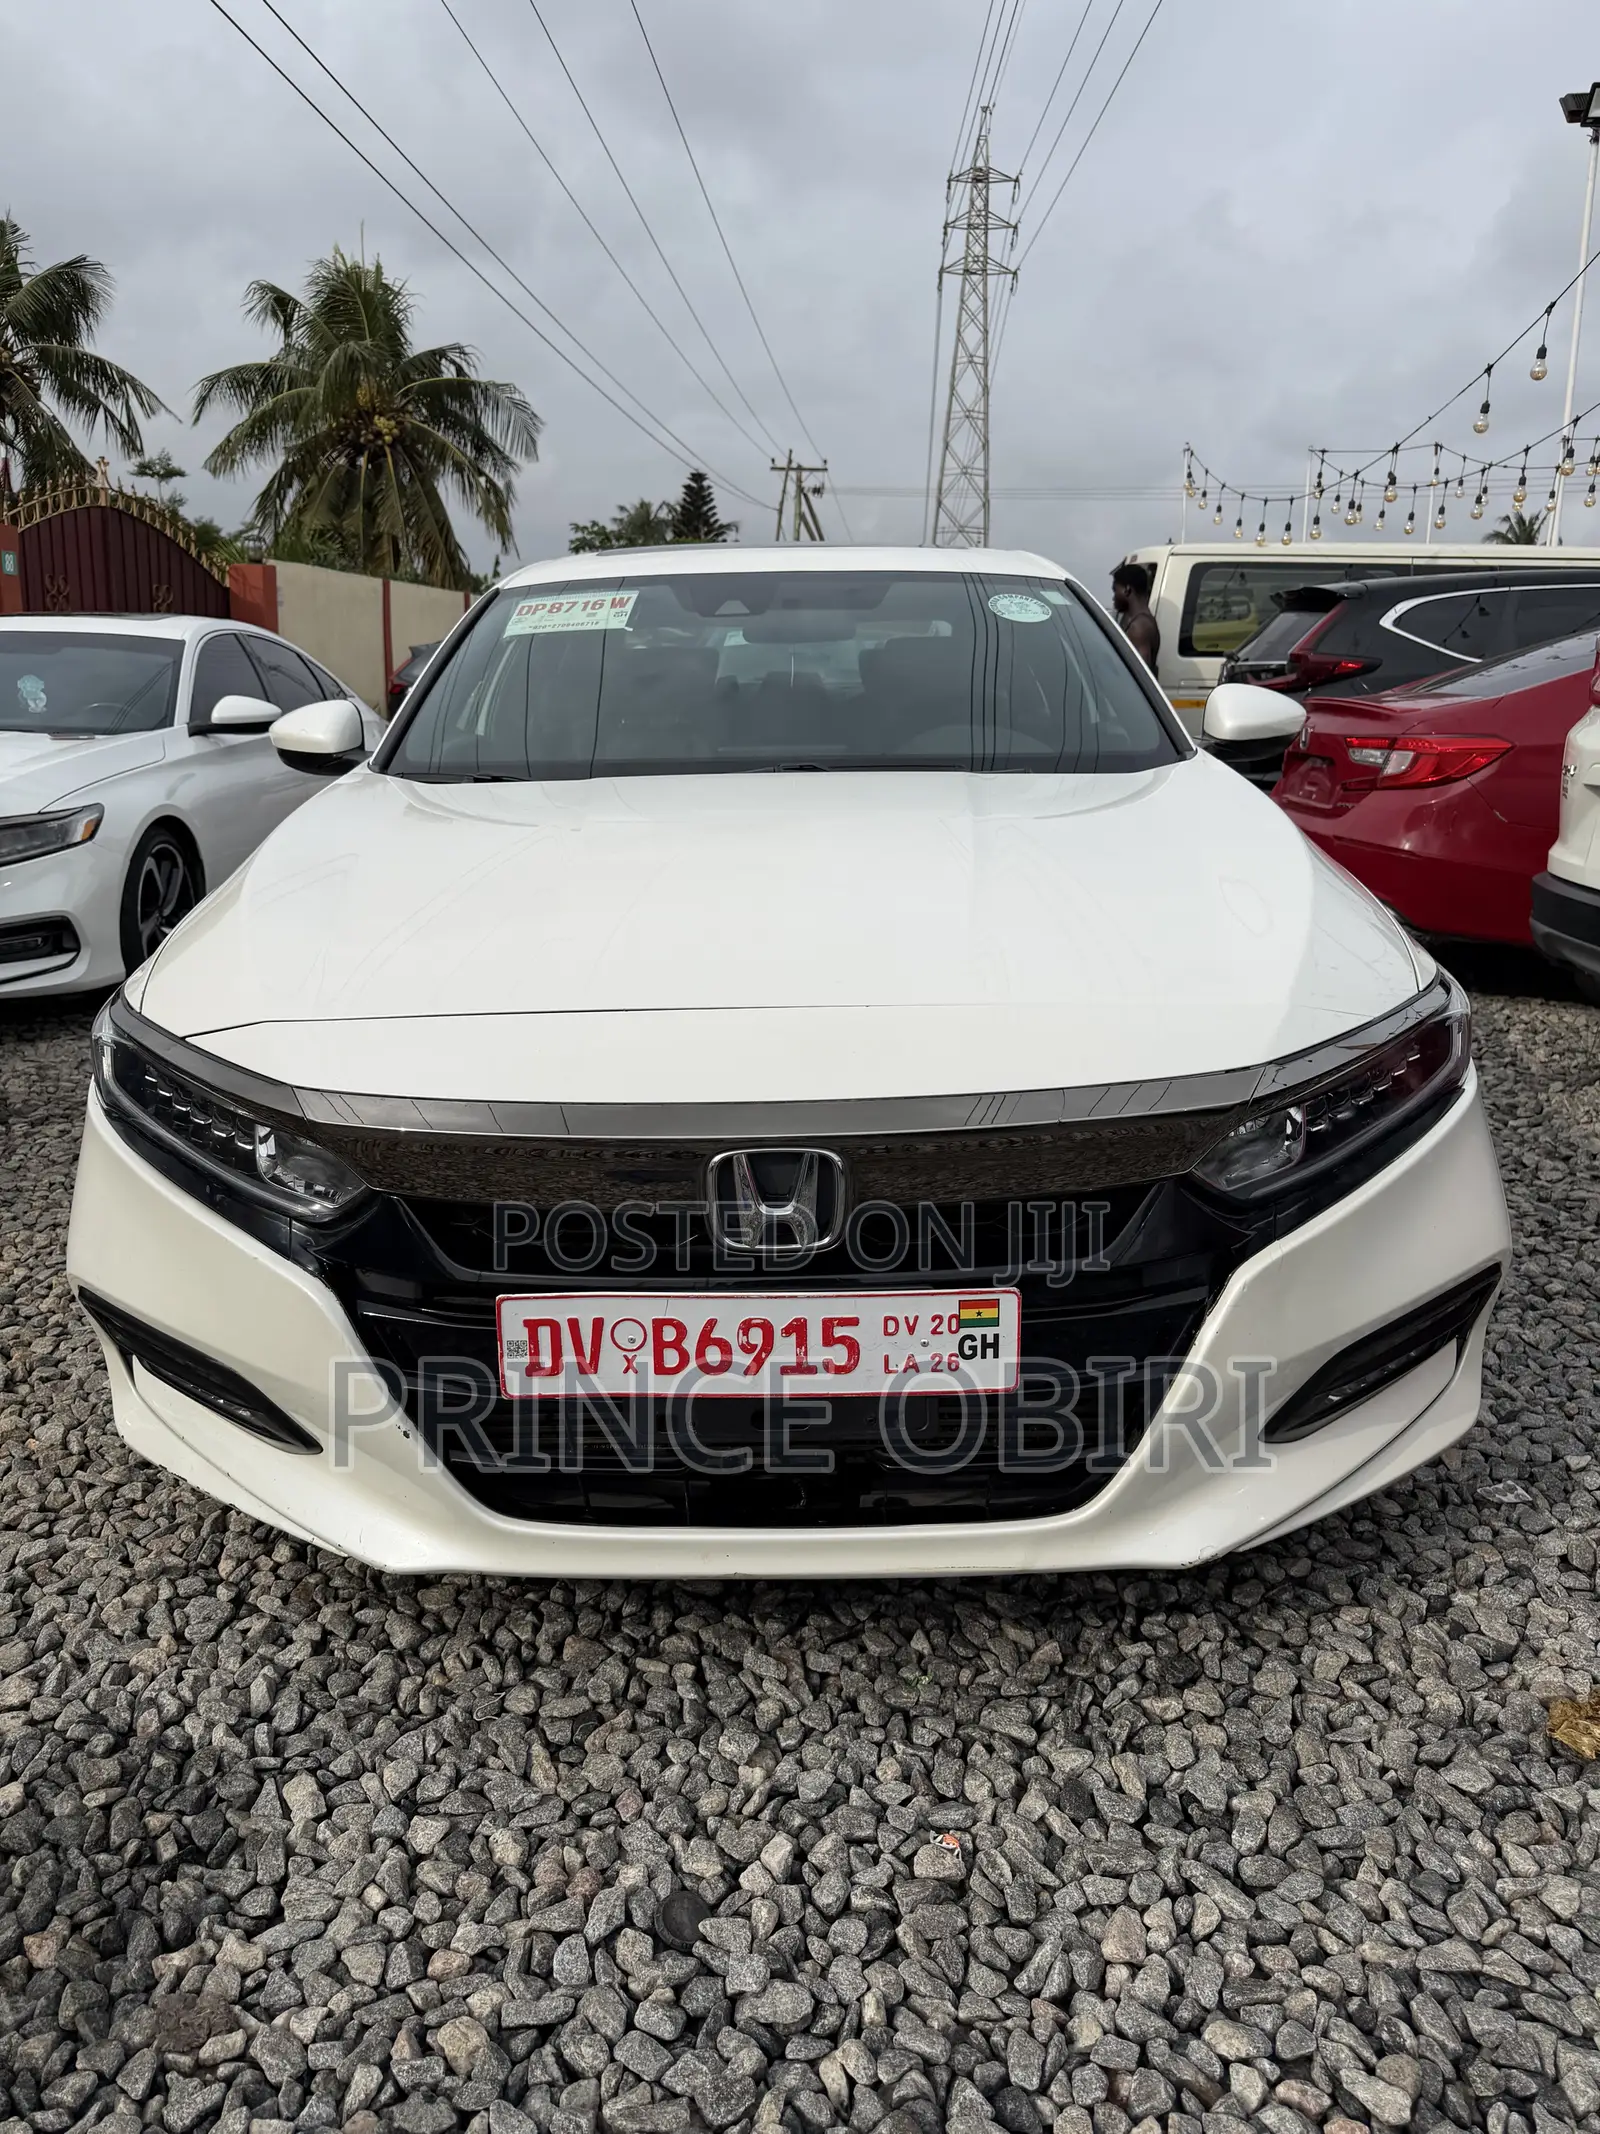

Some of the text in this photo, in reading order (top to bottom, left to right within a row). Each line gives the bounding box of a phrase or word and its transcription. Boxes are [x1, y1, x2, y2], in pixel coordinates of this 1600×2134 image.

[610, 596, 632, 609] W
[883, 1313, 960, 1337] DV 20
[522, 1316, 861, 1377] DV B6915
[957, 1333, 1000, 1361] GH
[883, 1352, 960, 1374] LA 26
